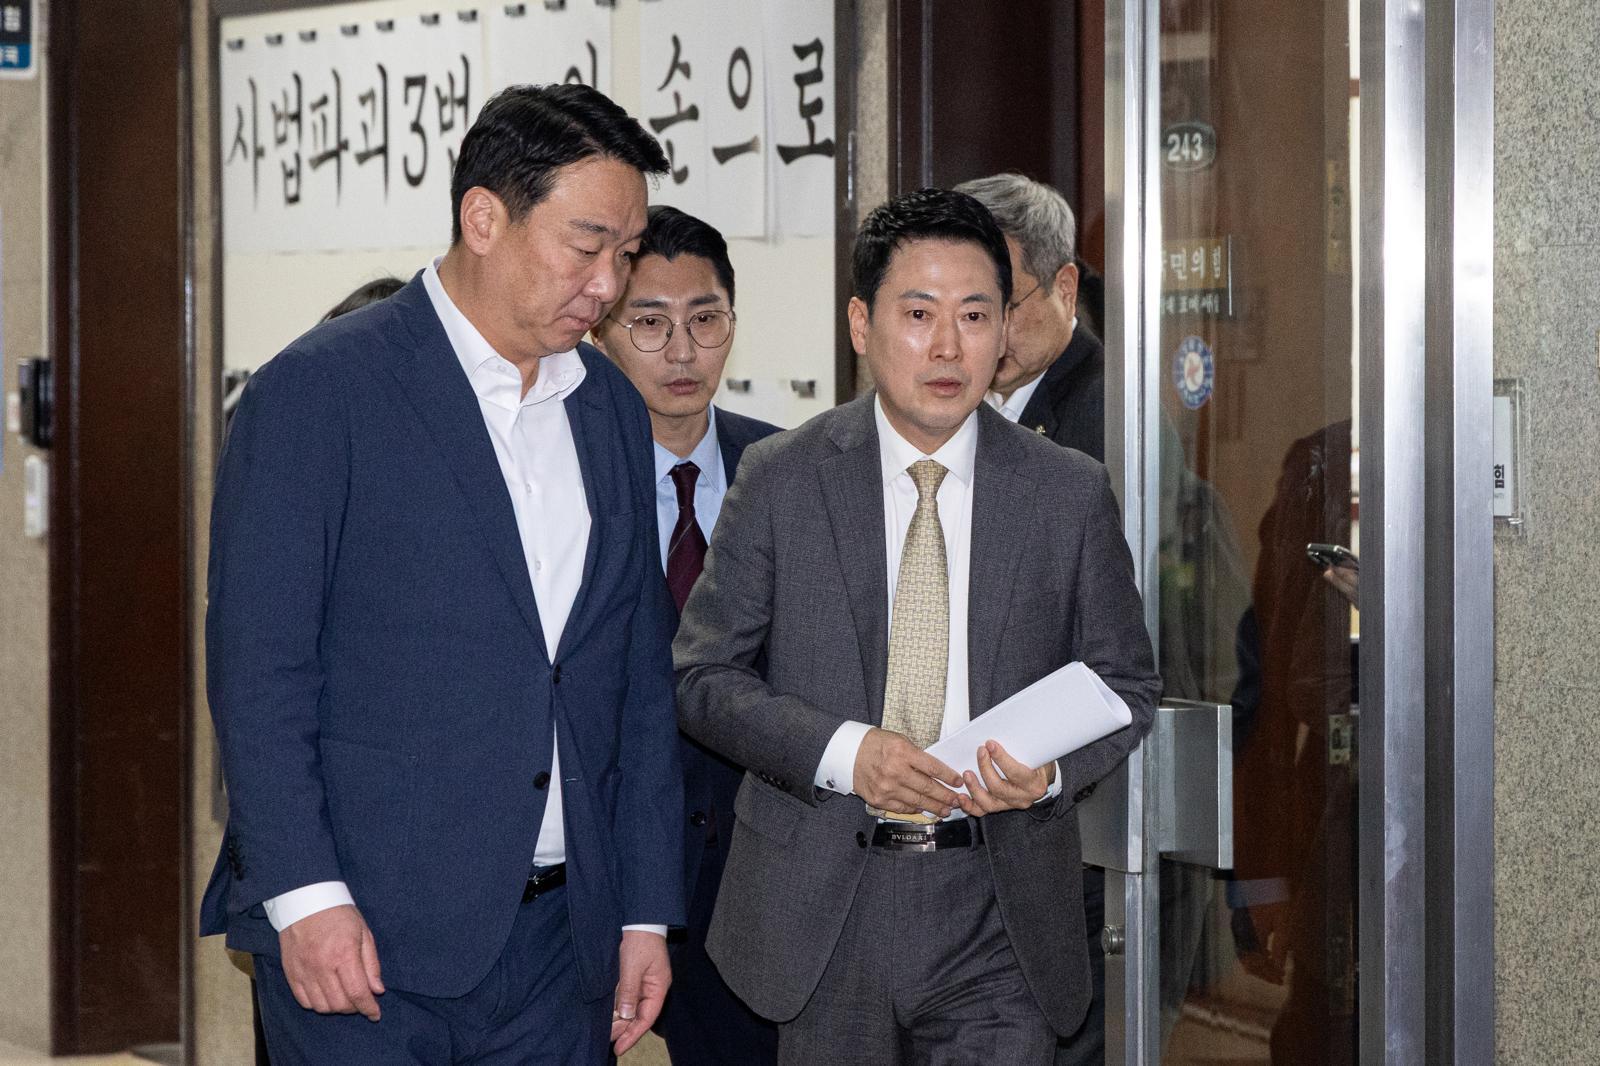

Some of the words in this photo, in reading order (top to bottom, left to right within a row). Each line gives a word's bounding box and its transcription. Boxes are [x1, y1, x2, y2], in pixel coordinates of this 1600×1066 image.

[649, 34, 836, 185] 손으로
[1167, 132, 1203, 162] 243
[1161, 246, 1221, 280] 민의힘
